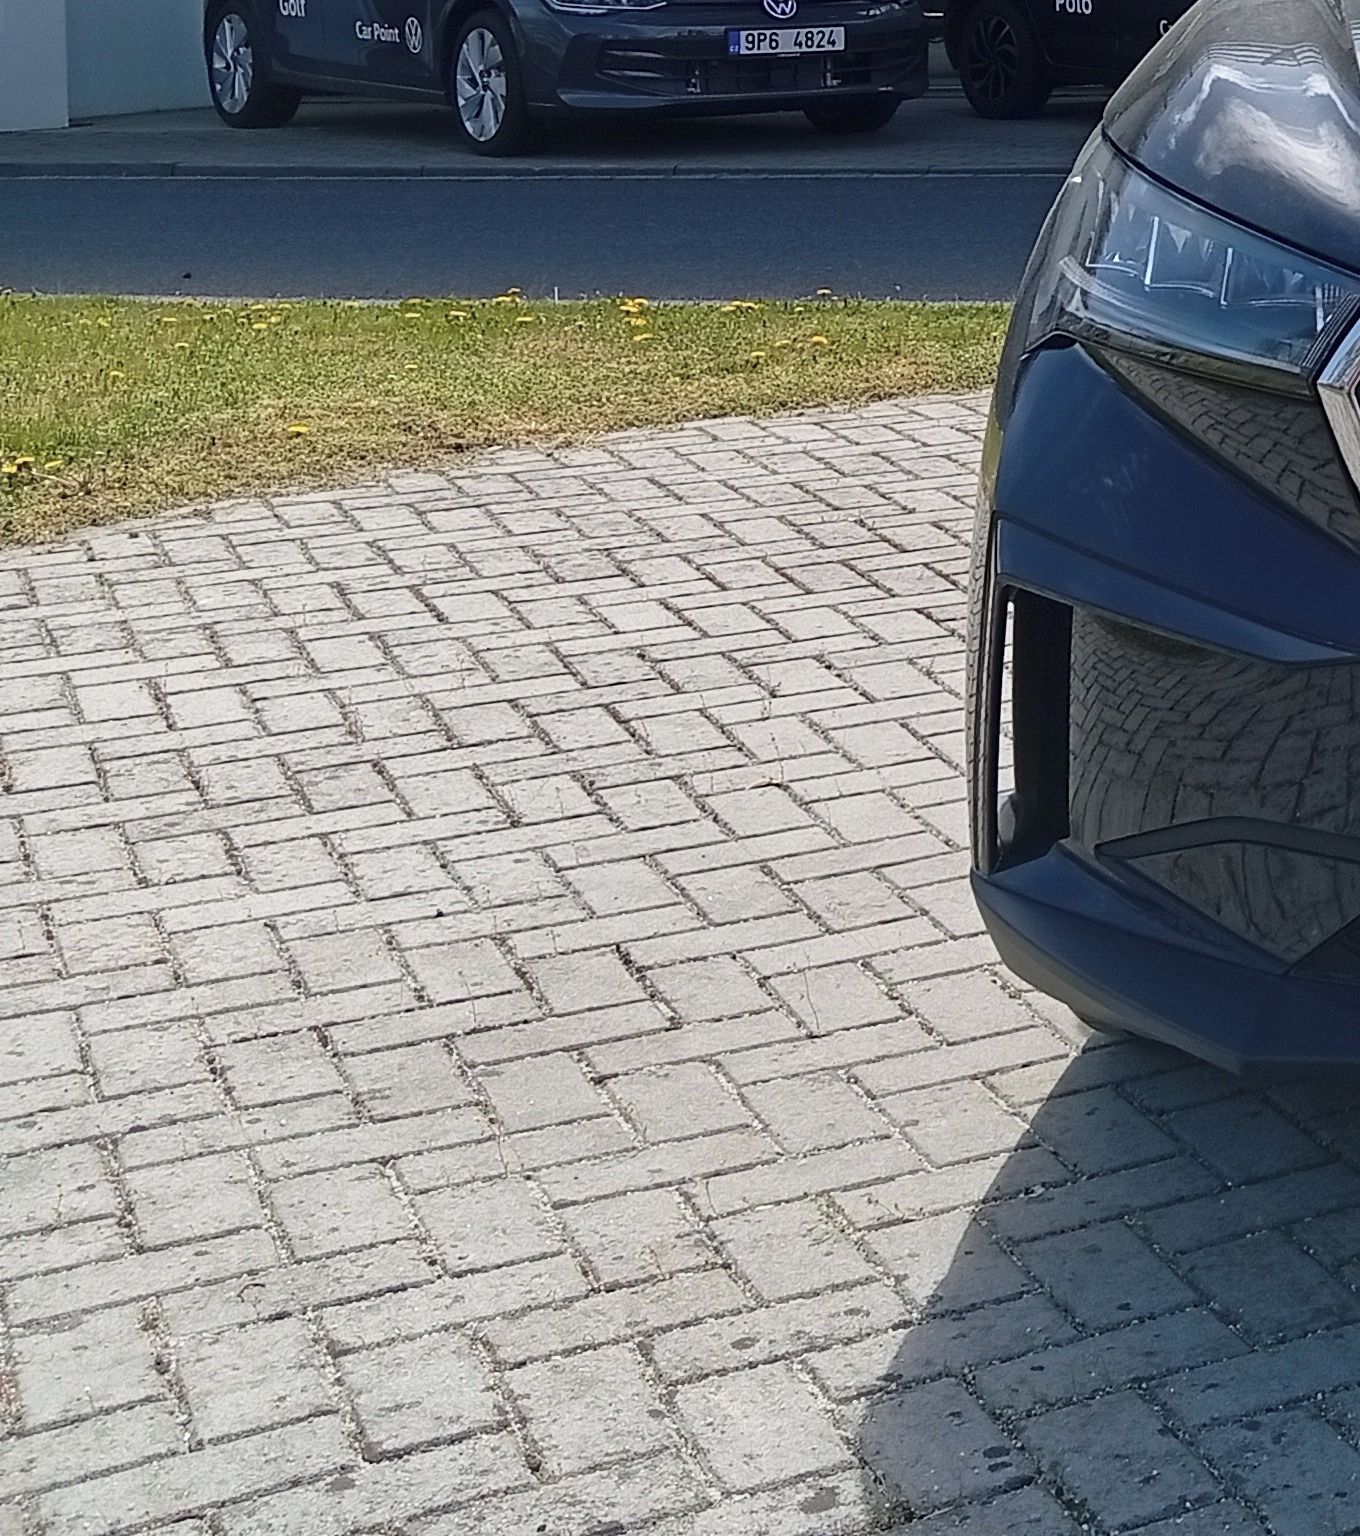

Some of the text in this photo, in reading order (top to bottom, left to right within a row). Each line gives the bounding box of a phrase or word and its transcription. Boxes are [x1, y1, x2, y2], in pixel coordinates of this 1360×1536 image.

[355, 21, 400, 43] Car Point
[744, 29, 837, 51] 9P6 4824
